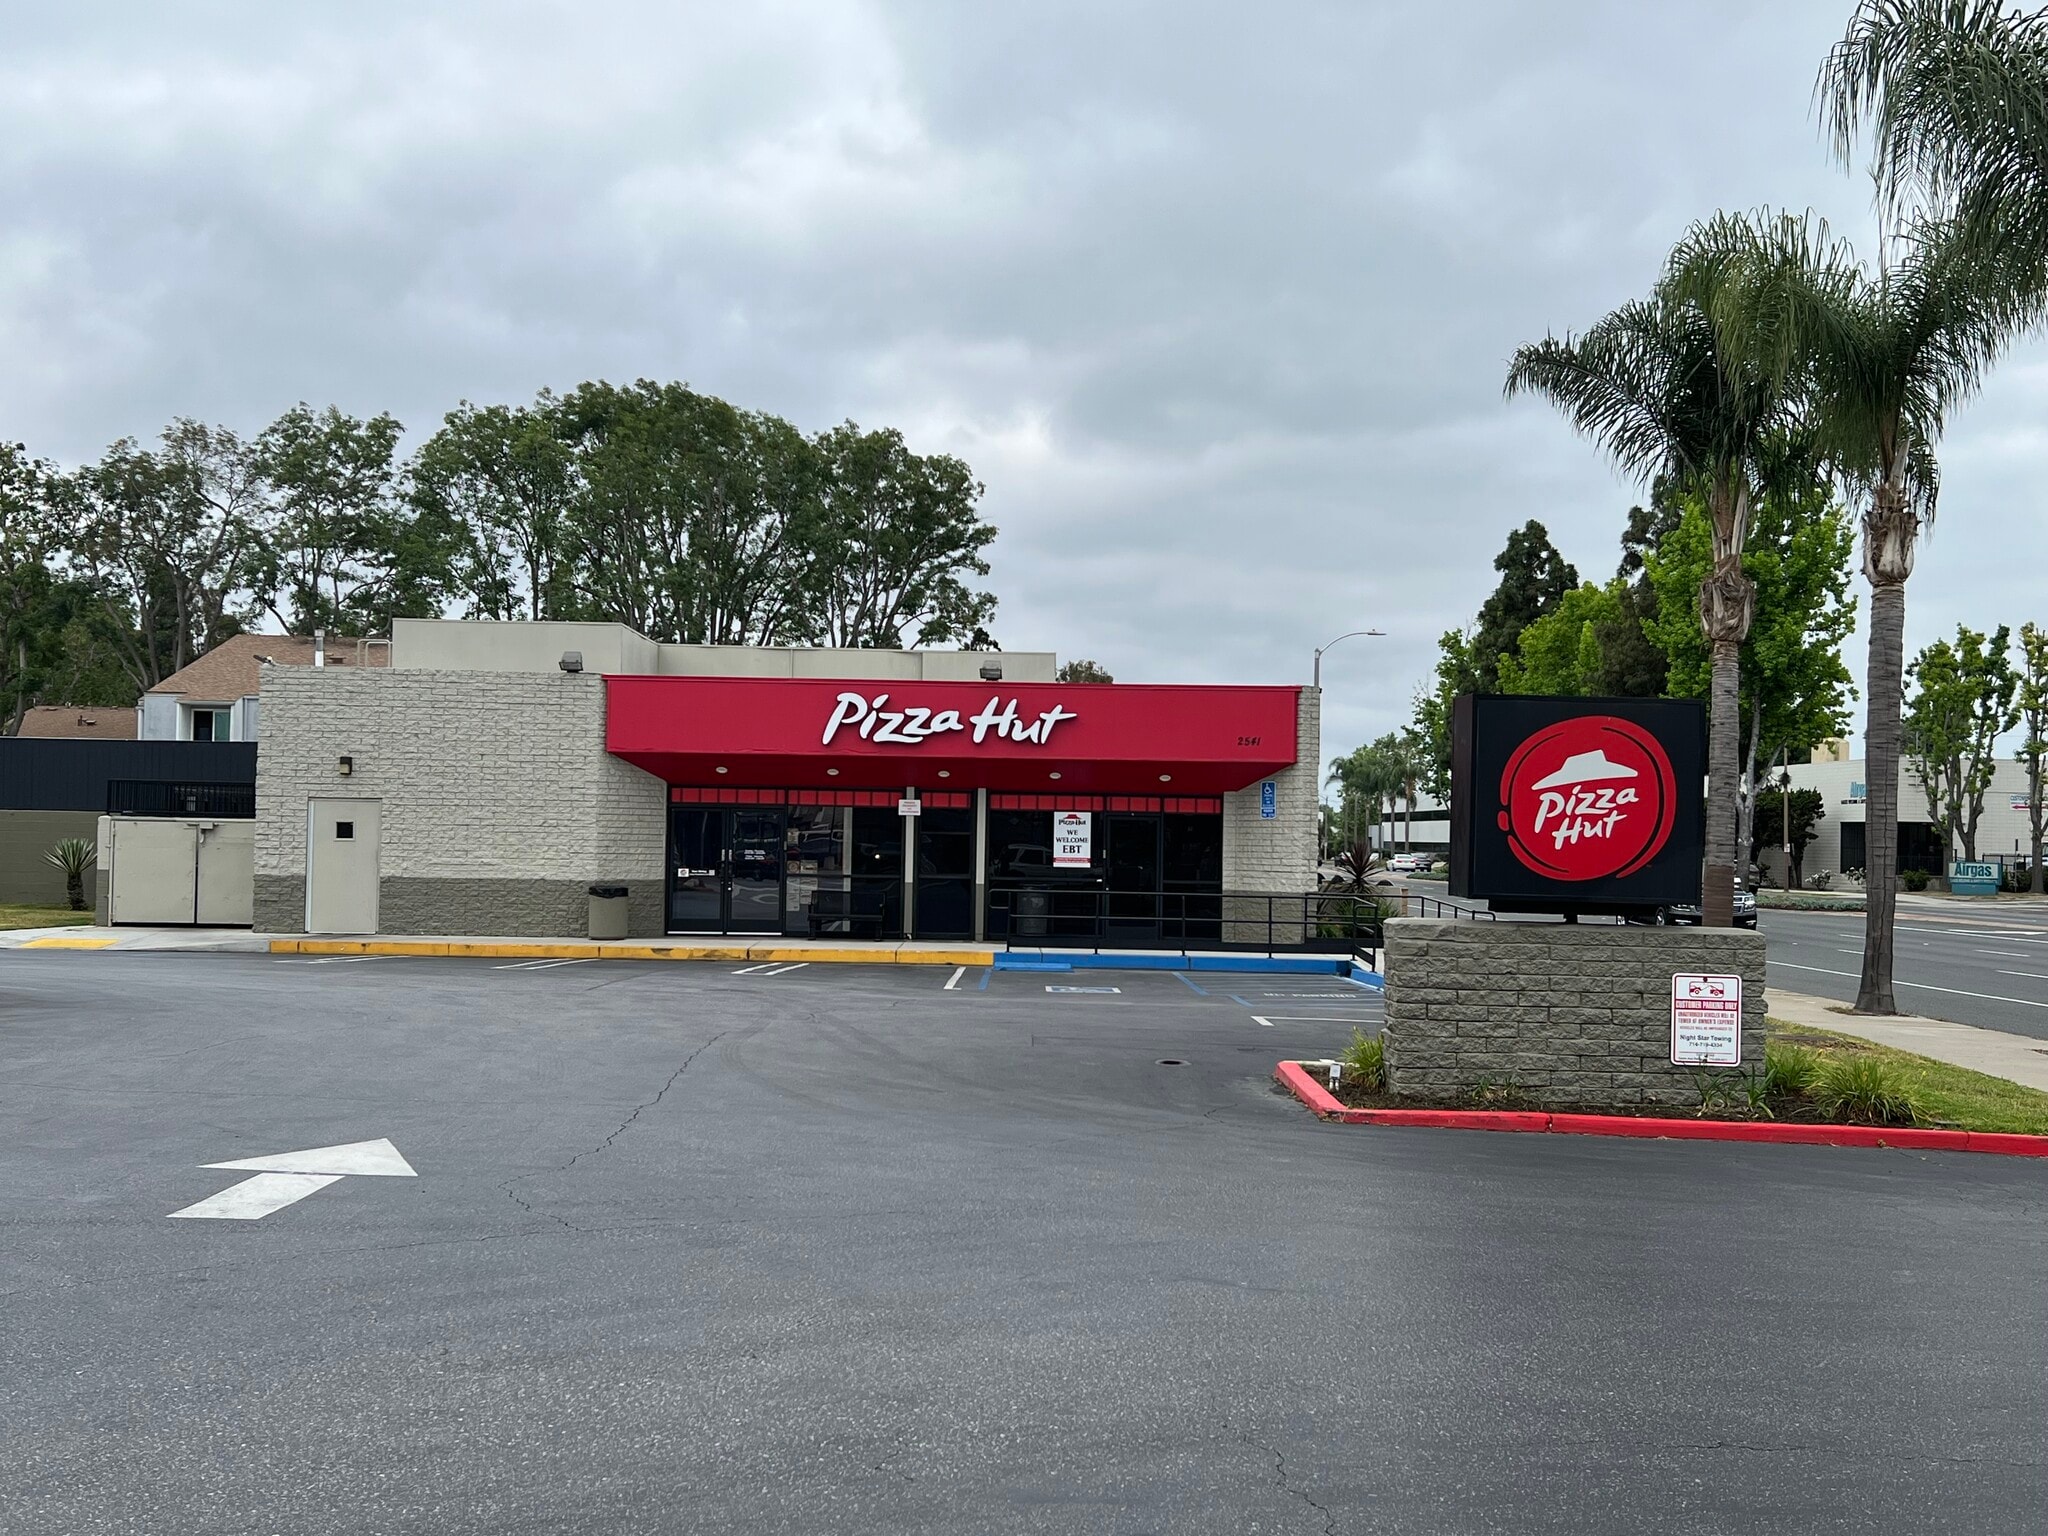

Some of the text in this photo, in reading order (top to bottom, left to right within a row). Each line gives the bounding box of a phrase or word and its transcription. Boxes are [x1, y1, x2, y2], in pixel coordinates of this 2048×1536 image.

[822, 692, 1078, 745] Pizza Hut
[1237, 736, 1261, 746] 2541
[1534, 785, 1640, 834] Pizza
[1551, 810, 1628, 850] Hut
[1062, 845, 1082, 854] EBT
[1954, 861, 1992, 878] Airgas
[1711, 1035, 1732, 1043] Towing
